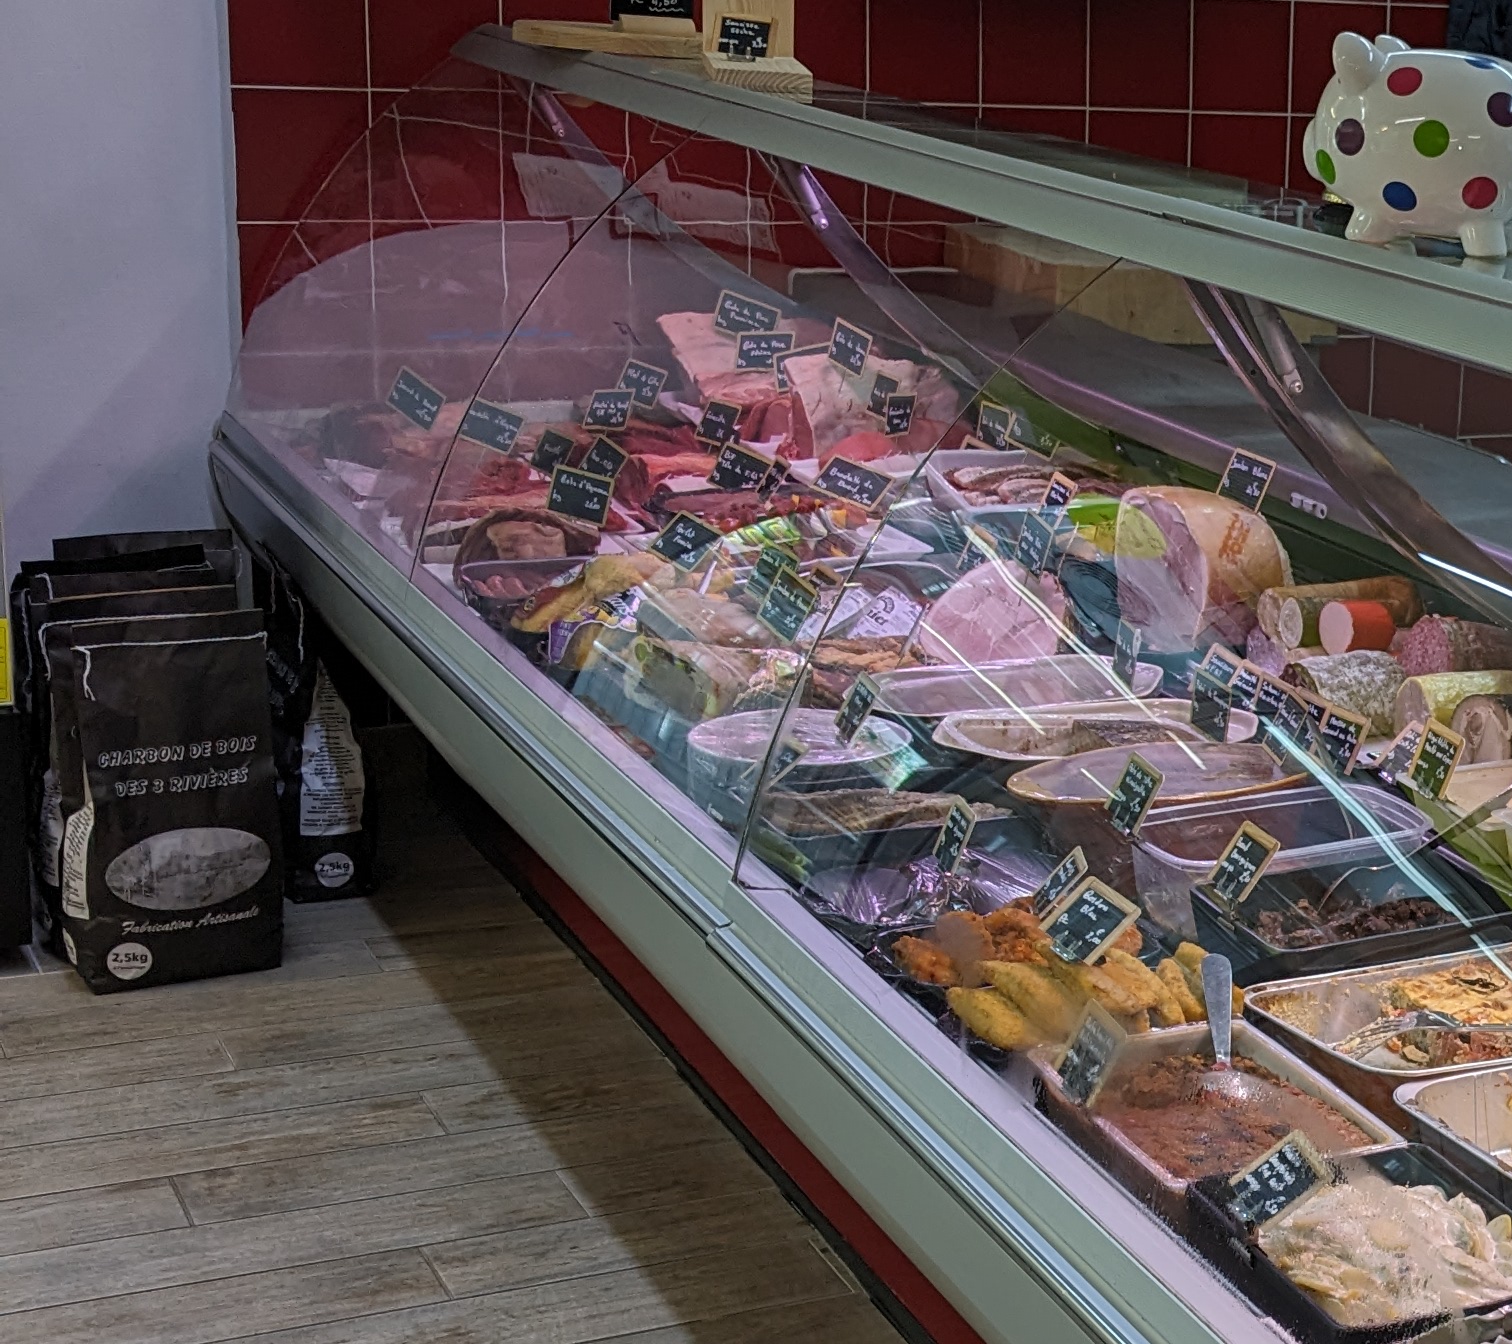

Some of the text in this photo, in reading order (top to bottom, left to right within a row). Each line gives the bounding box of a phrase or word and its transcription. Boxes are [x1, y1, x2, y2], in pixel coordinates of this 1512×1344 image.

[98, 735, 256, 769] CHARBON DE BOIS
[115, 765, 248, 798] DES 3 RIVIÈRES
[121, 905, 260, 936] Fabrication Artisanale
[111, 951, 149, 965] 2,5kg
